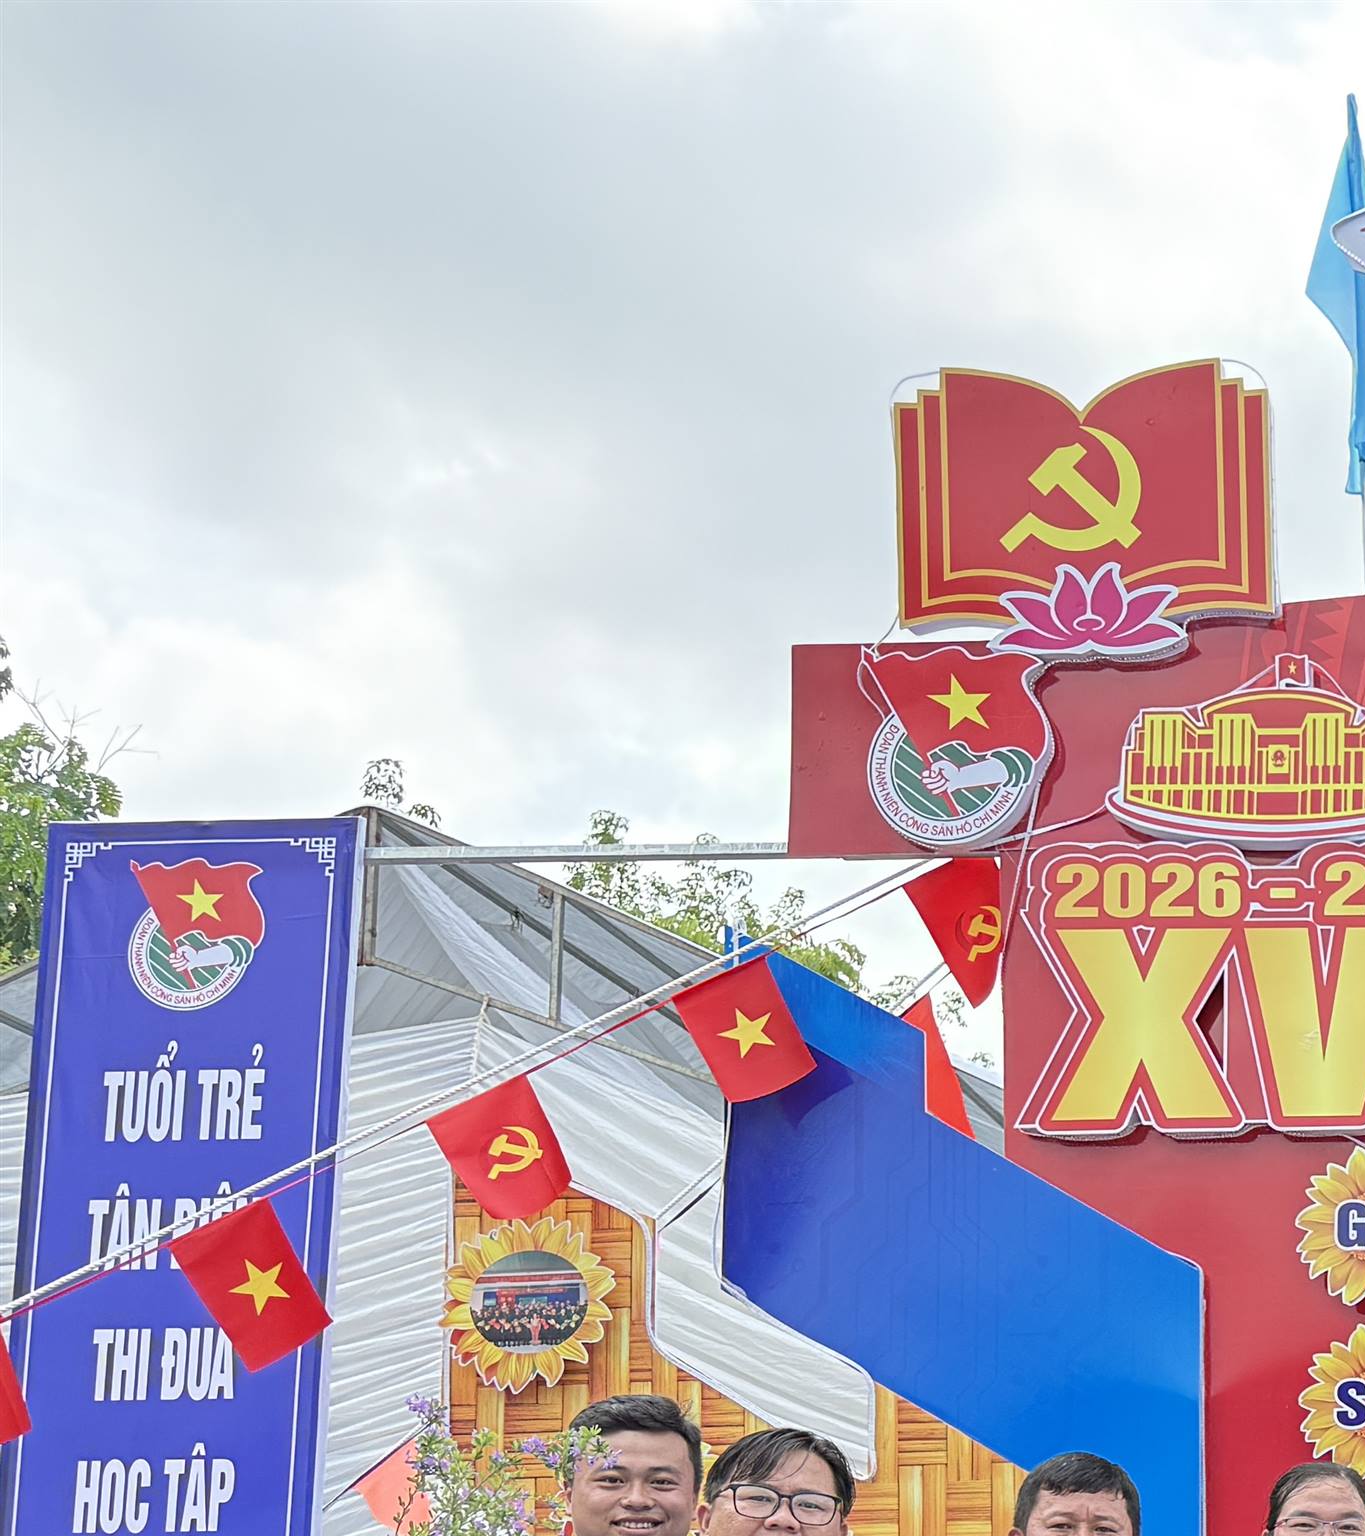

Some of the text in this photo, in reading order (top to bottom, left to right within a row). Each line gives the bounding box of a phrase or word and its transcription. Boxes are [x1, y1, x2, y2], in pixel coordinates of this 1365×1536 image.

[875, 756, 889, 793] THANH
[989, 790, 1014, 818] MINH
[1054, 860, 1242, 919] 2026
[103, 1041, 267, 1143] TUỔI TRẺ
[88, 1182, 163, 1271] TÂN
[93, 1327, 235, 1402] THI ĐUA
